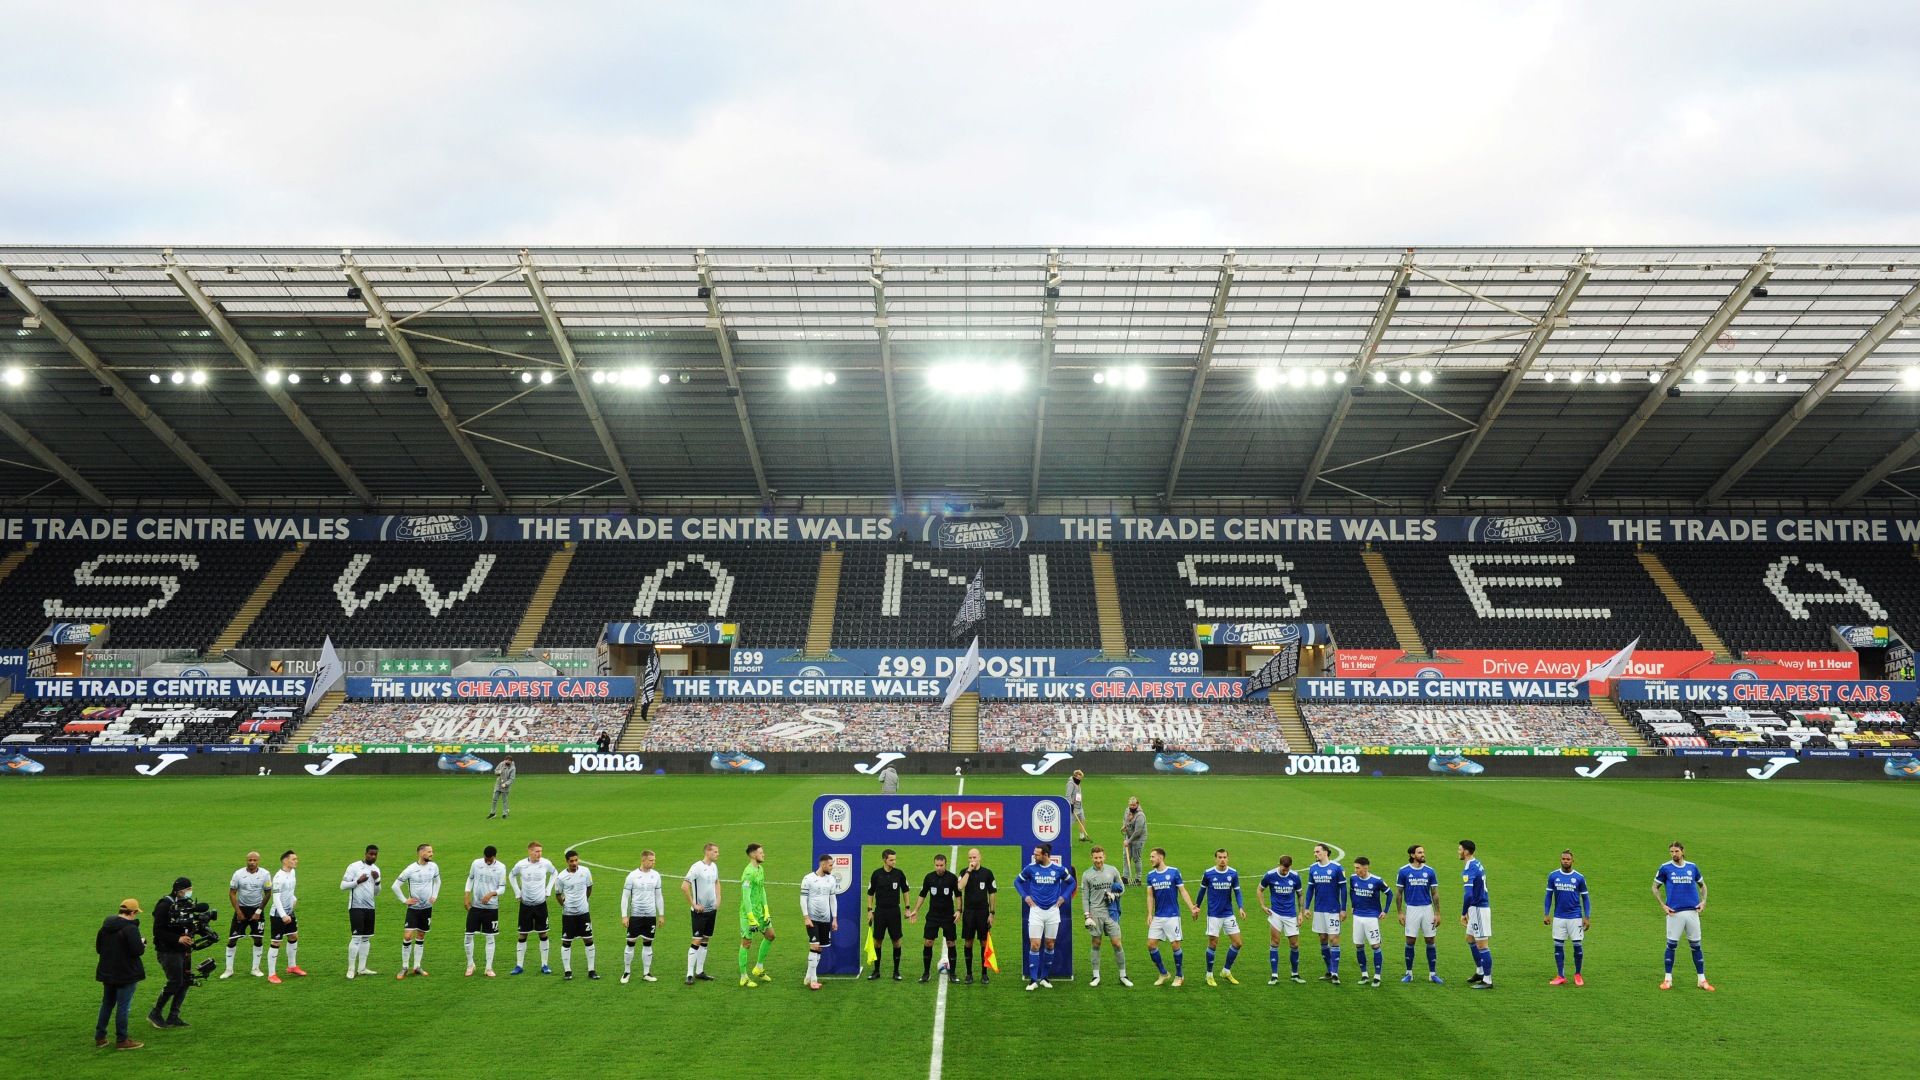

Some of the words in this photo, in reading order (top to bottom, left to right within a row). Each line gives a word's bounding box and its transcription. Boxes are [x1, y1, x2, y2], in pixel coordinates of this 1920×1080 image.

[407, 515, 460, 527] TRADE
[949, 522, 1003, 533] TRADE
[1495, 516, 1549, 528] TRADE
[32, 518, 127, 540] TRADE
[136, 518, 245, 540] CENTRE
[253, 518, 351, 540] WALES
[412, 522, 457, 537] CENTRE
[518, 518, 570, 540] THE
[579, 518, 673, 540] TRADE
[681, 518, 788, 540] CENTRE
[796, 518, 893, 540] WALES
[1060, 518, 1112, 540] THE
[1120, 518, 1214, 540] TRADE
[1223, 518, 1334, 541] CENTRE
[1339, 518, 1437, 541] WALES
[1501, 523, 1545, 538] CENTRE
[1608, 519, 1661, 541] THE
[1669, 519, 1770, 541] TRADE
[1776, 519, 1888, 541] CENTRE
[955, 530, 999, 544] CENTRE
[651, 628, 694, 641] CENTRE
[1240, 628, 1283, 642] CENTRE
[34, 645, 52, 657] THE
[733, 651, 763, 665] £99
[1340, 653, 1358, 661] Drive
[1360, 653, 1378, 663] Away
[1889, 648, 1907, 660] THE
[0, 656, 23, 665] SIT!
[27, 653, 57, 670] TRADE
[1169, 652, 1199, 665] £99
[1807, 659, 1818, 668] In
[1819, 659, 1824, 668] 1
[1827, 659, 1852, 669] Hour
[286, 660, 375, 674] TRUILOT
[878, 655, 926, 677] £99
[1483, 659, 1529, 674] Drive
[1534, 659, 1580, 678] Away
[1622, 662, 1665, 675] Hour
[35, 680, 73, 696] THE
[79, 680, 147, 696] TRADE
[153, 679, 231, 696] CENTRE
[237, 680, 306, 696] WALES
[371, 682, 404, 697] THE
[410, 682, 452, 697] UK'S
[457, 681, 553, 698] CHEAPEST
[558, 680, 609, 698] CARS
[673, 679, 710, 695] THE
[716, 679, 783, 695] TRADE
[788, 679, 865, 695] CENTRE
[872, 679, 940, 696] WALES
[1005, 683, 1038, 697] THE
[1044, 683, 1085, 697] UK'S
[1091, 681, 1187, 698] CHEAPEST
[1191, 681, 1243, 698] CARS
[1307, 681, 1345, 697] THE
[1353, 681, 1420, 697] TRADE
[1429, 681, 1503, 697] CENTRE
[1509, 681, 1579, 698] WALES
[1645, 685, 1681, 700] THE
[1685, 685, 1728, 700] UK'S
[1733, 683, 1832, 701] CHEAPEST
[1837, 683, 1891, 701] CARS
[420, 707, 471, 717] COME
[475, 707, 501, 717] ON
[507, 707, 541, 717] YOU
[1059, 708, 1142, 724] THANK
[1151, 708, 1204, 724] YOU
[1395, 710, 1518, 723] SWANSEA
[404, 717, 534, 738] SWANS
[1132, 723, 1204, 739] ARMY
[886, 803, 936, 836] sky
[948, 805, 997, 830] bet
[828, 824, 844, 833] EFL
[1038, 825, 1054, 833] EFL
[1329, 919, 1340, 927] 30
[1578, 924, 1583, 932] 7
[1370, 929, 1380, 939] 23
